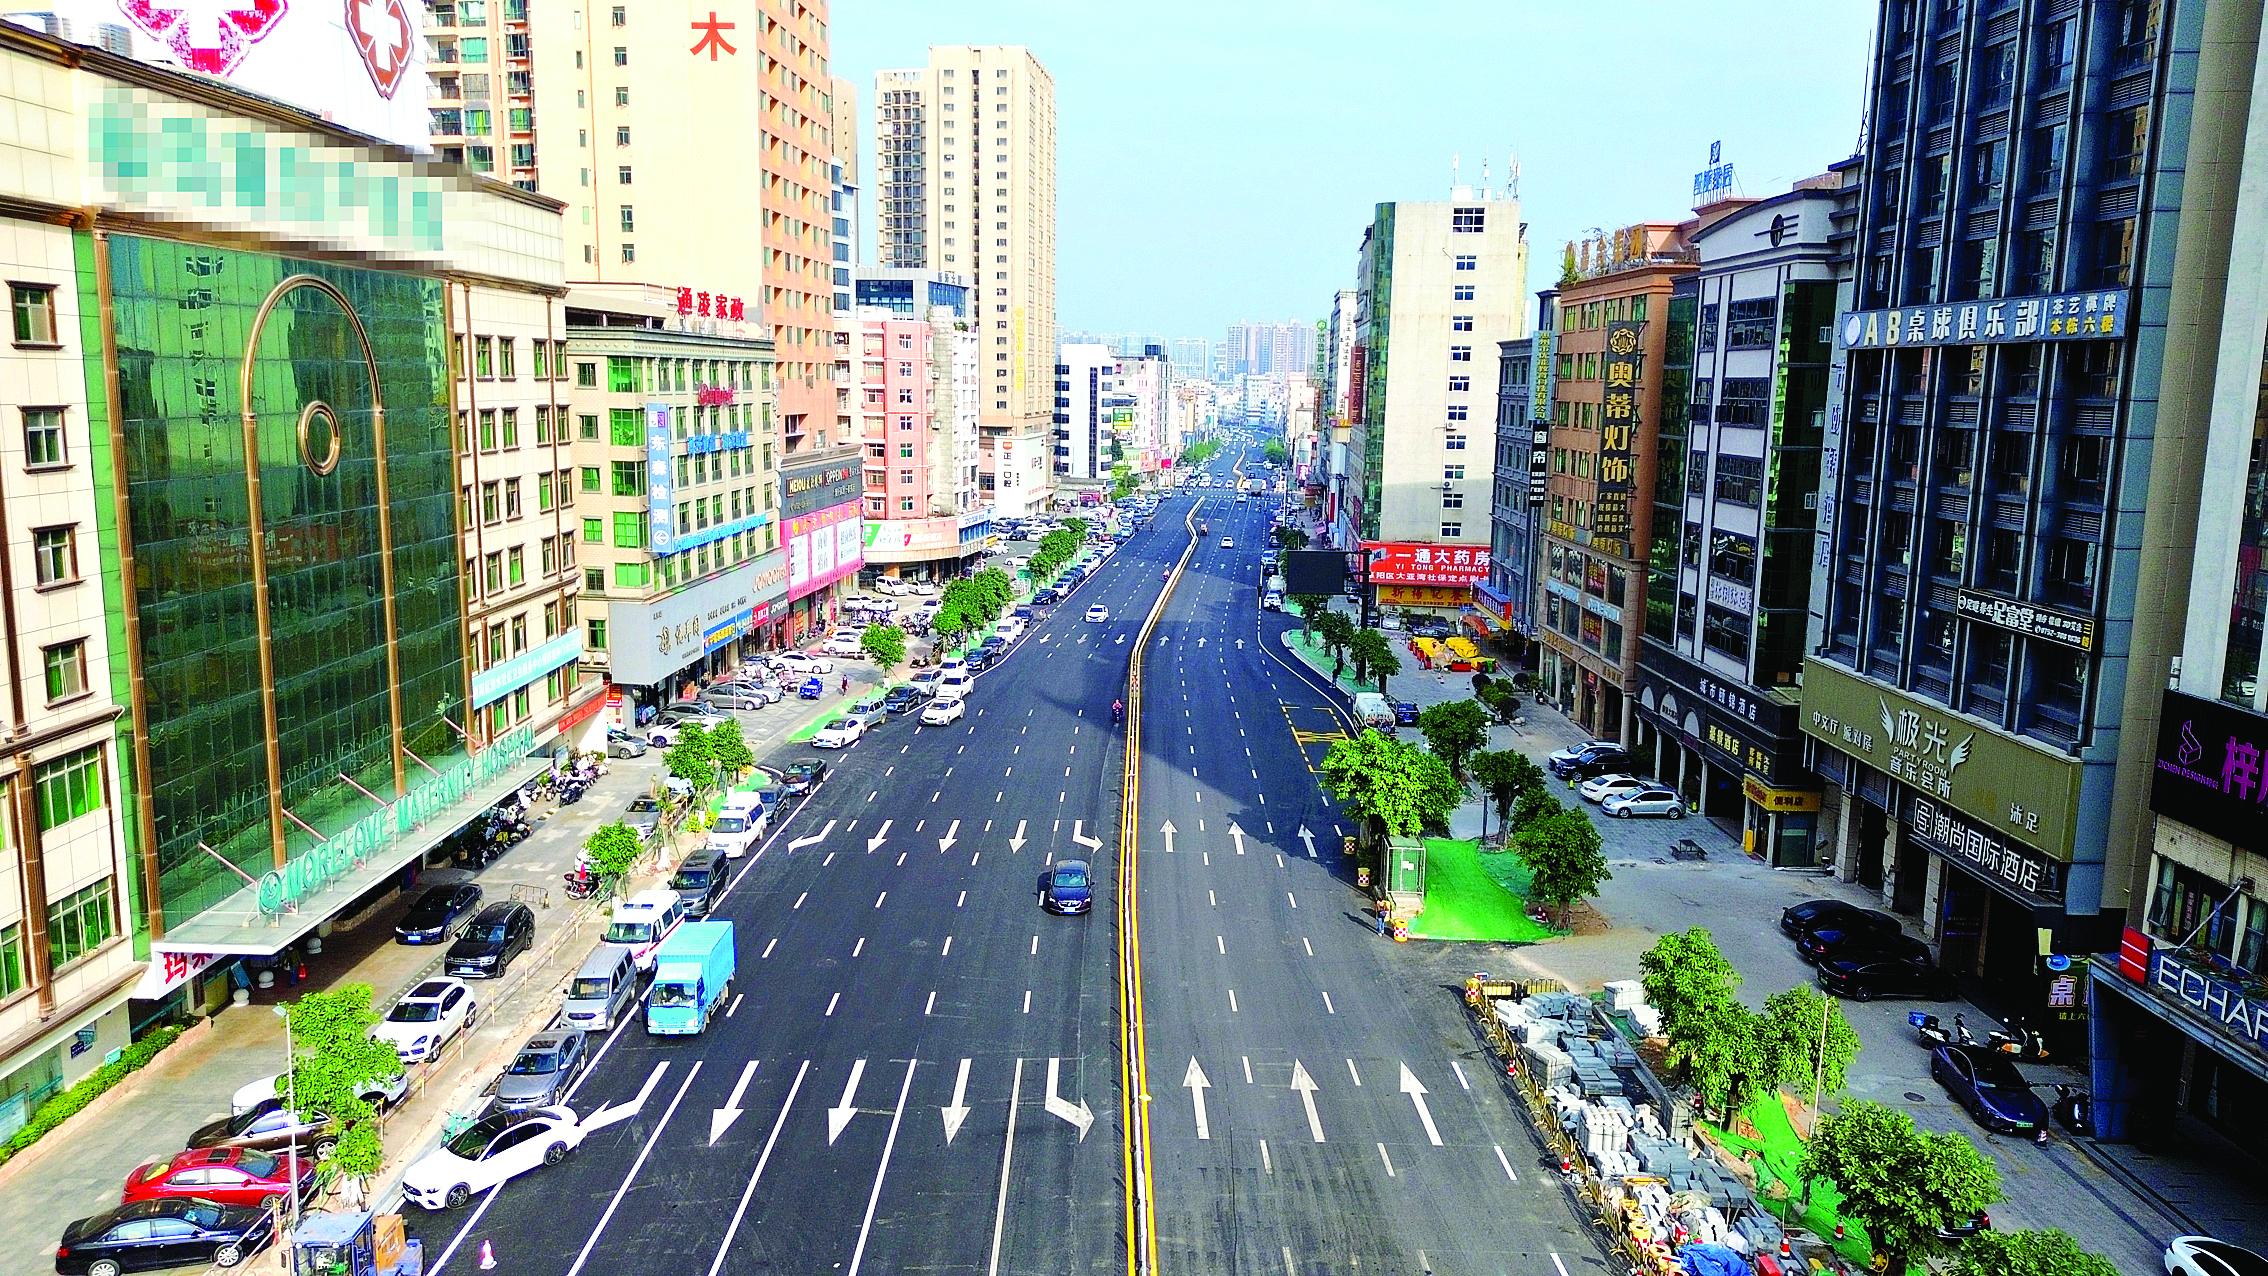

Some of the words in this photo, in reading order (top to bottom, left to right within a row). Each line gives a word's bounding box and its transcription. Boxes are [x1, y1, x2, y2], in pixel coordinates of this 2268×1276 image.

[689, 11, 737, 61] 木
[677, 286, 744, 321] 通凌家政
[2052, 293, 2118, 314] 茶艺棋牌
[2050, 314, 2114, 335] 本栋六楼
[1601, 362, 1634, 483] 奥蒂灯饰
[1533, 431, 1547, 463] 窗帘
[650, 434, 669, 524] 东森检测
[1395, 548, 1491, 565] 一通大药房
[1441, 565, 1490, 573] PHARMACY
[1699, 677, 1758, 722] 城市颐锦酒店
[1812, 710, 1838, 735] 中文厅
[1843, 723, 1873, 754] 派对屋
[1896, 708, 1949, 765] 极光
[395, 756, 475, 833] MATERNITY
[1889, 754, 1952, 800] 音乐会所
[1773, 795, 1804, 807] 便利店
[1933, 811, 2041, 892] 潮尚国际酒店
[2048, 975, 2089, 1008] 桌
[2058, 1011, 2089, 1022] 请上六
